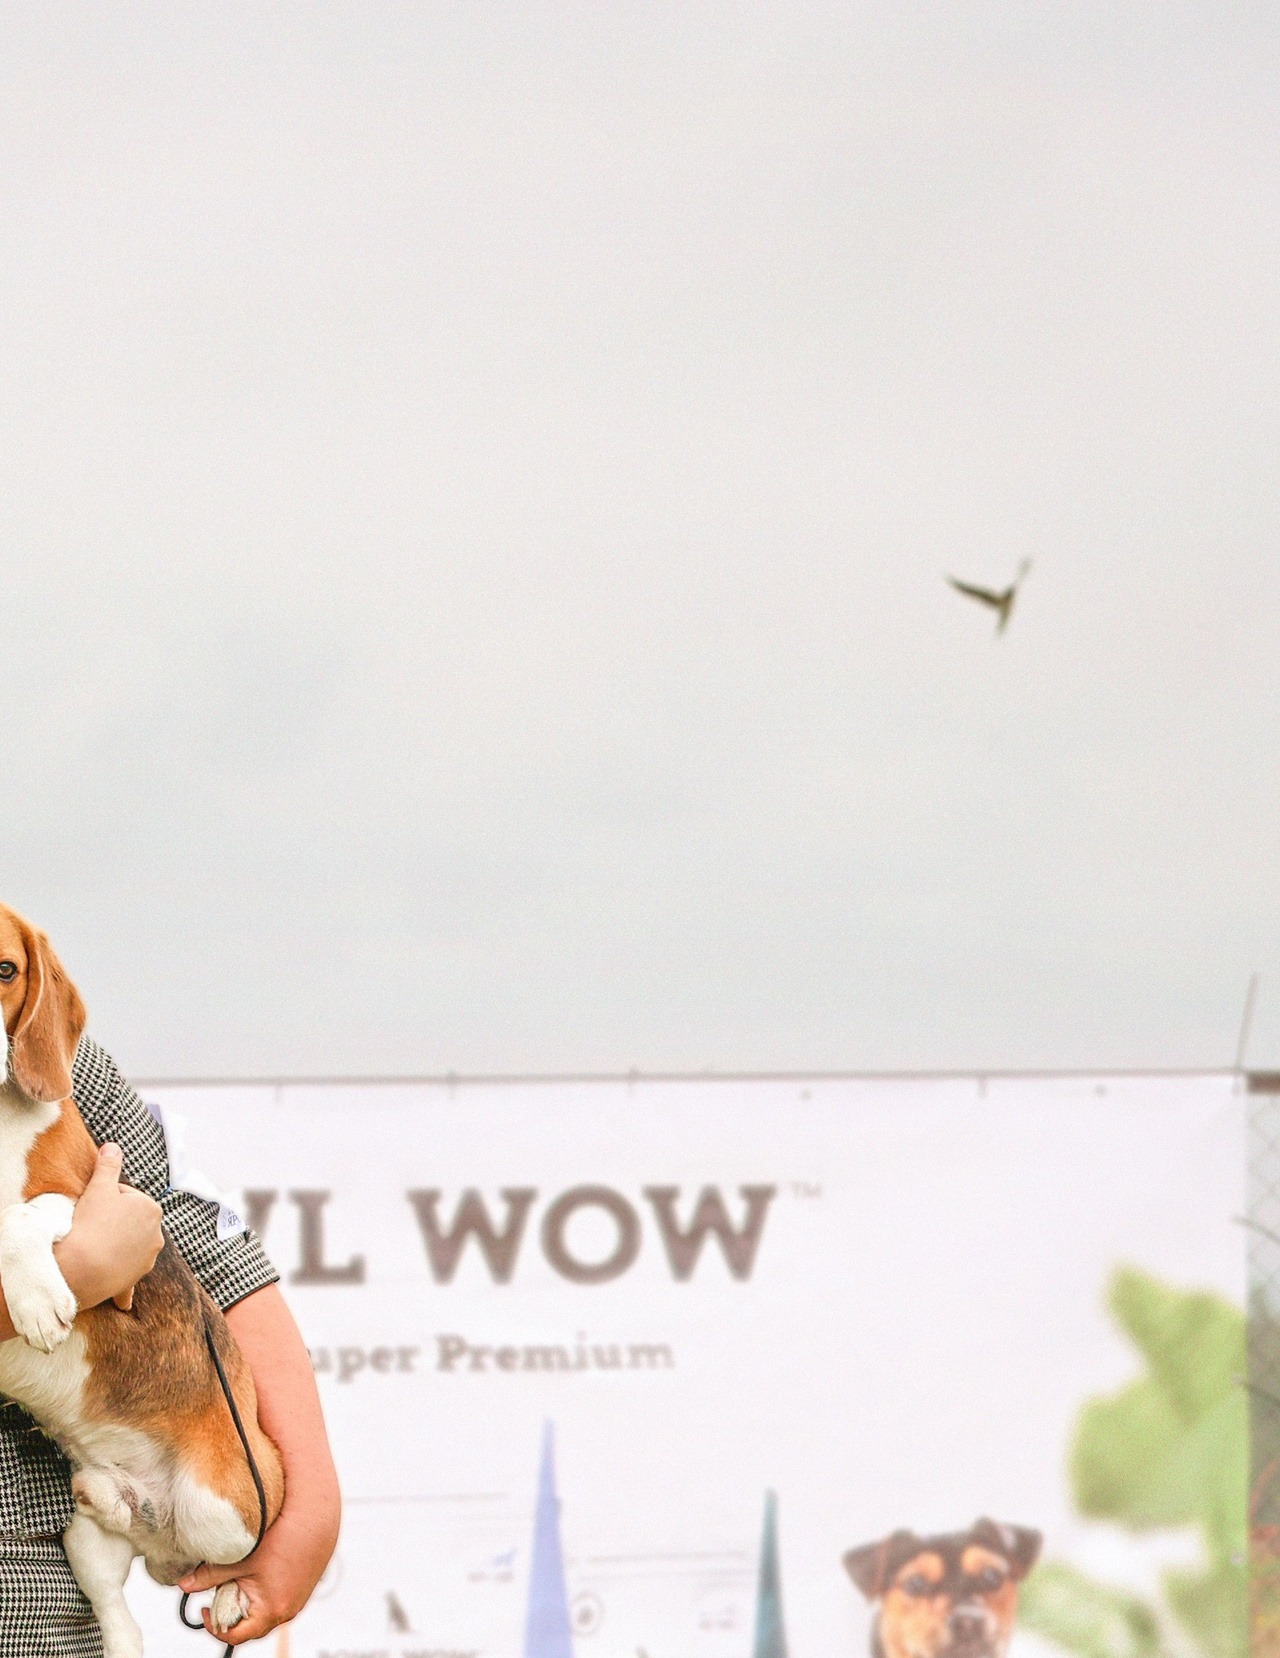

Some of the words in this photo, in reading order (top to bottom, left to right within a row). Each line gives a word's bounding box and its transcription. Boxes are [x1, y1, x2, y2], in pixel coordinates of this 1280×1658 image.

[406, 1183, 777, 1286] WOW
[311, 1347, 422, 1384] uper
[435, 1332, 675, 1373] Premium
